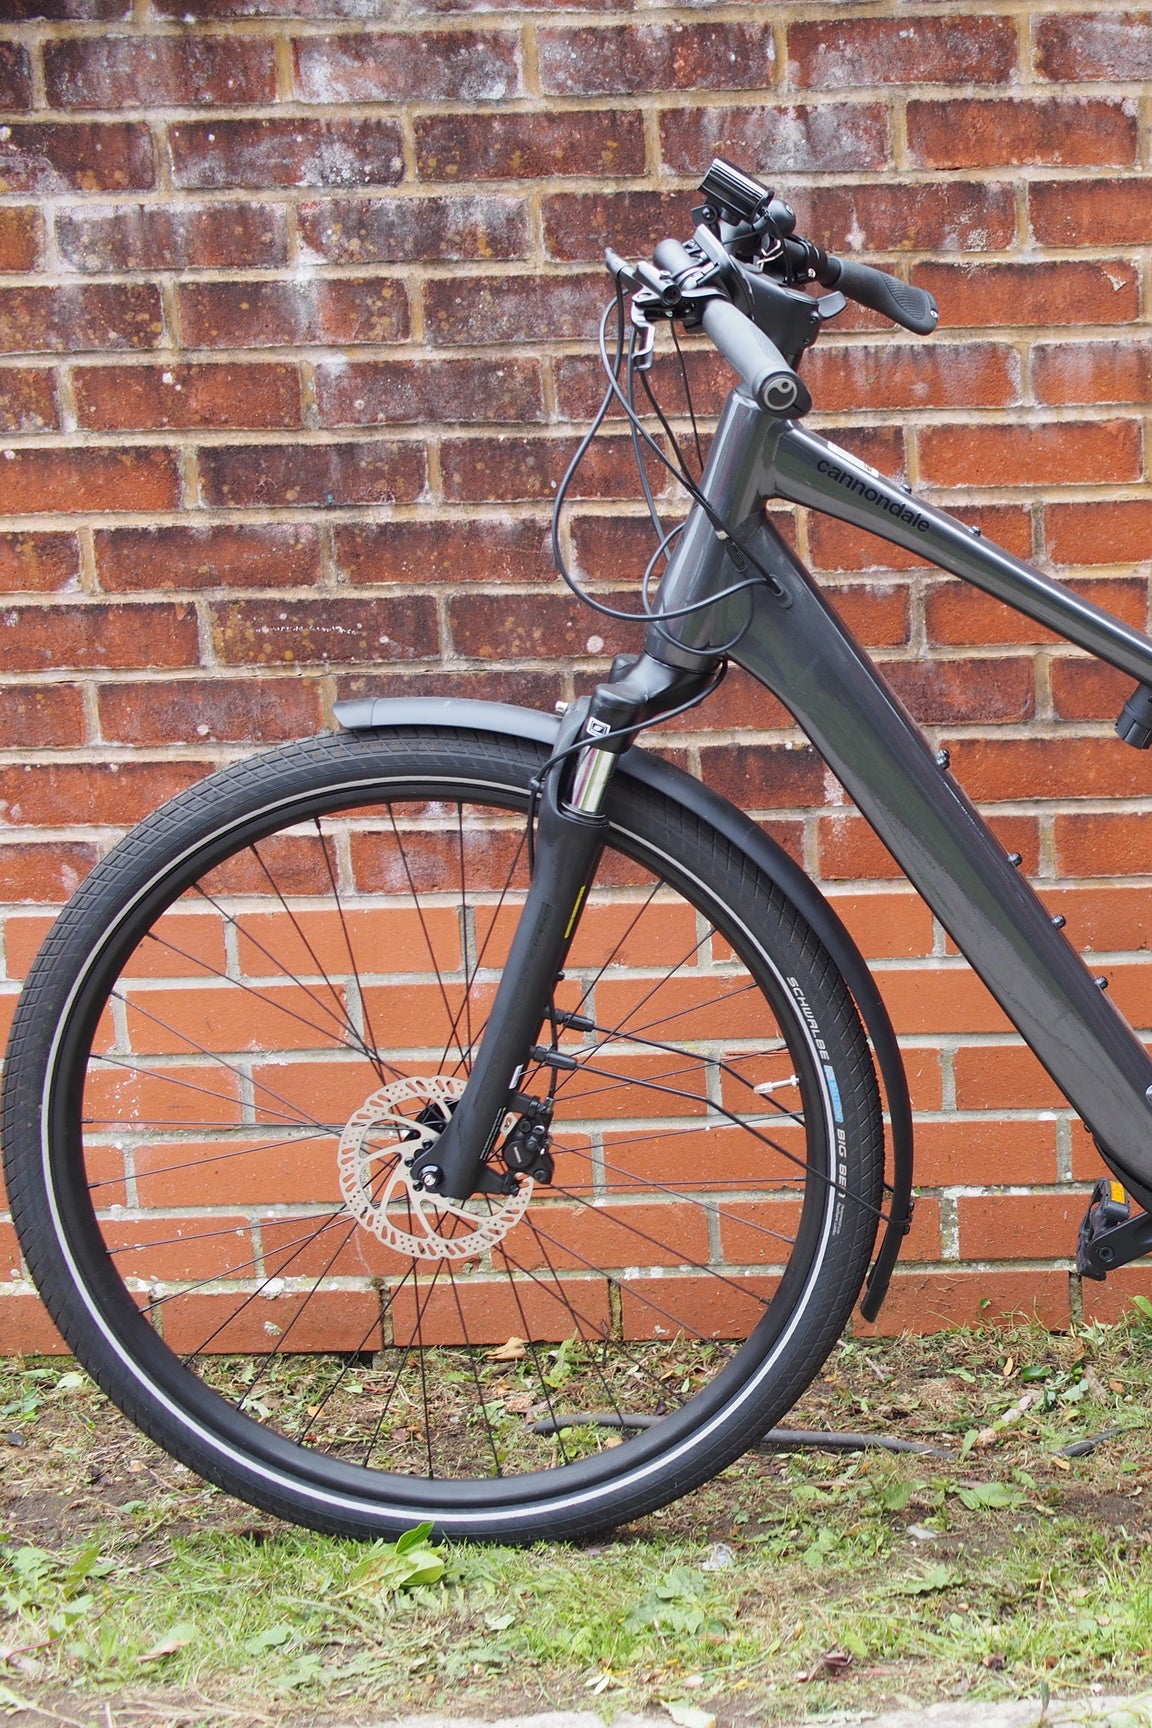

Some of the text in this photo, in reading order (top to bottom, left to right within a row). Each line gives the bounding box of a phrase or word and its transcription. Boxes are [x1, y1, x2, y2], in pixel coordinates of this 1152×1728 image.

[816, 459, 930, 532] cannondale
[786, 976, 830, 1060] SCHWALBE
[836, 1128, 847, 1158] BIG
